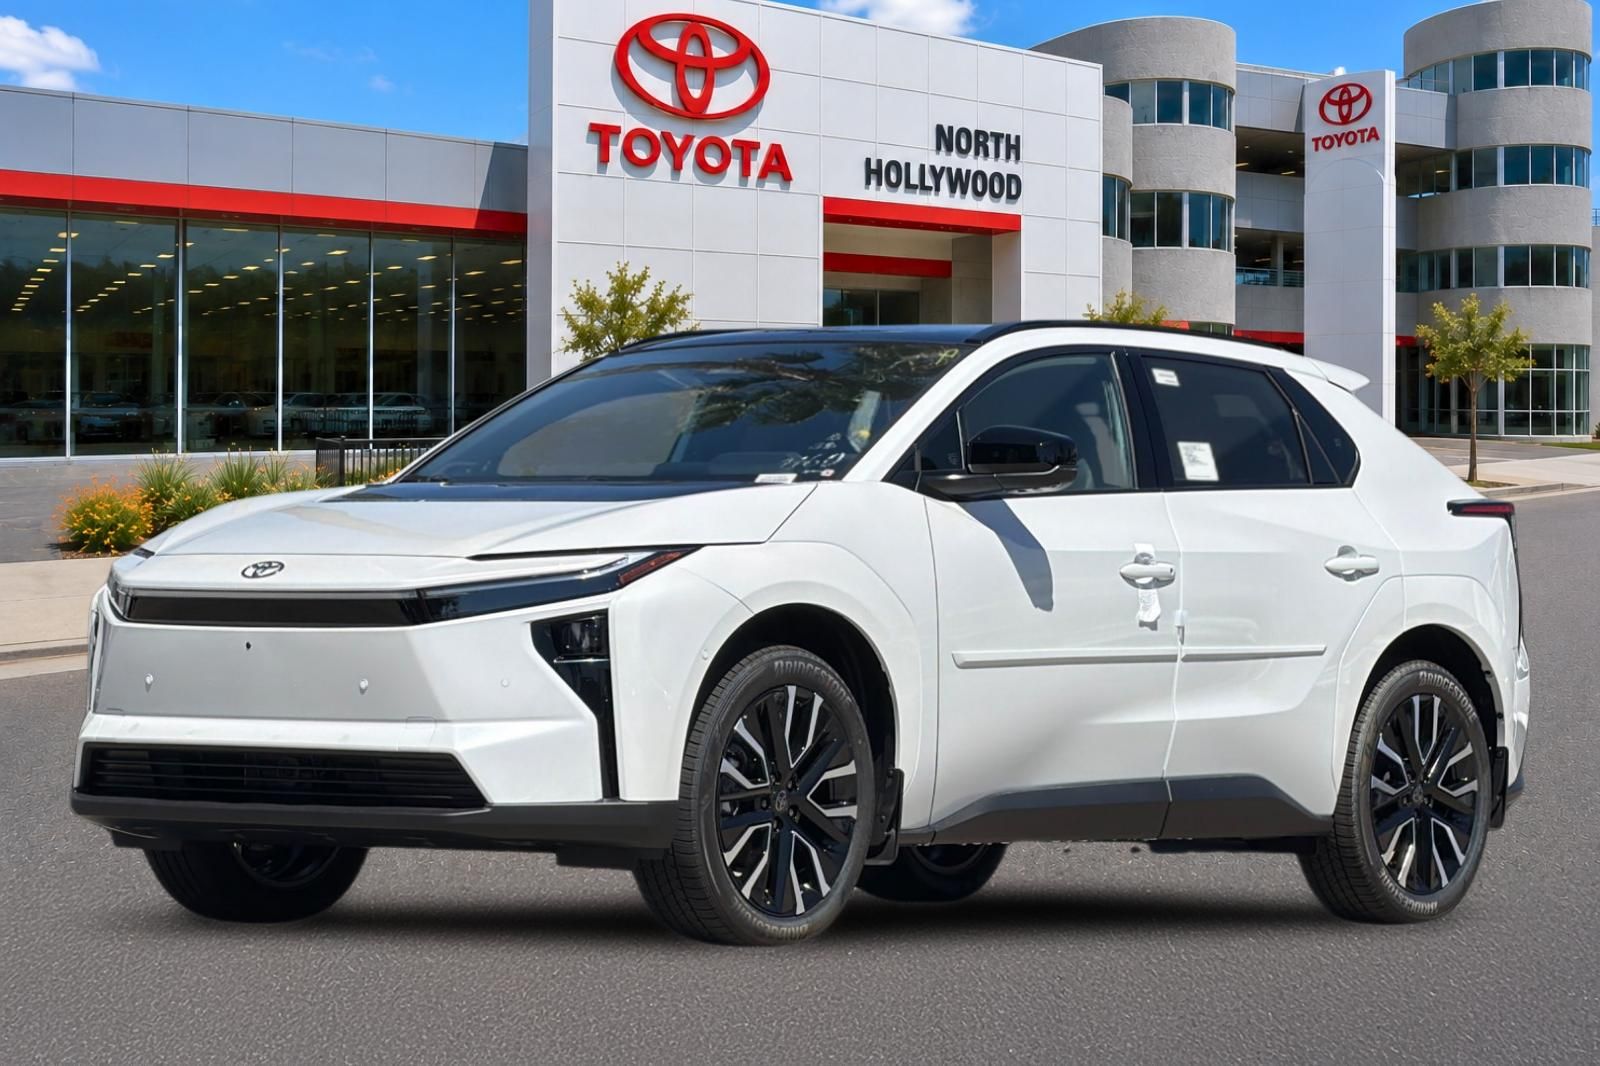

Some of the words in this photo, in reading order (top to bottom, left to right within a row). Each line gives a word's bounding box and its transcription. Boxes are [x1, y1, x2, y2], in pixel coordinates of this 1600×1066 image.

[588, 122, 793, 181] TOYOTA
[935, 123, 1021, 161] NORTH
[1311, 126, 1380, 152] TOYOTA
[865, 157, 1022, 200] HOLLYWOOD
[774, 660, 853, 706] BRIDGESTONE
[1419, 670, 1478, 723] BRIDGESTONE
